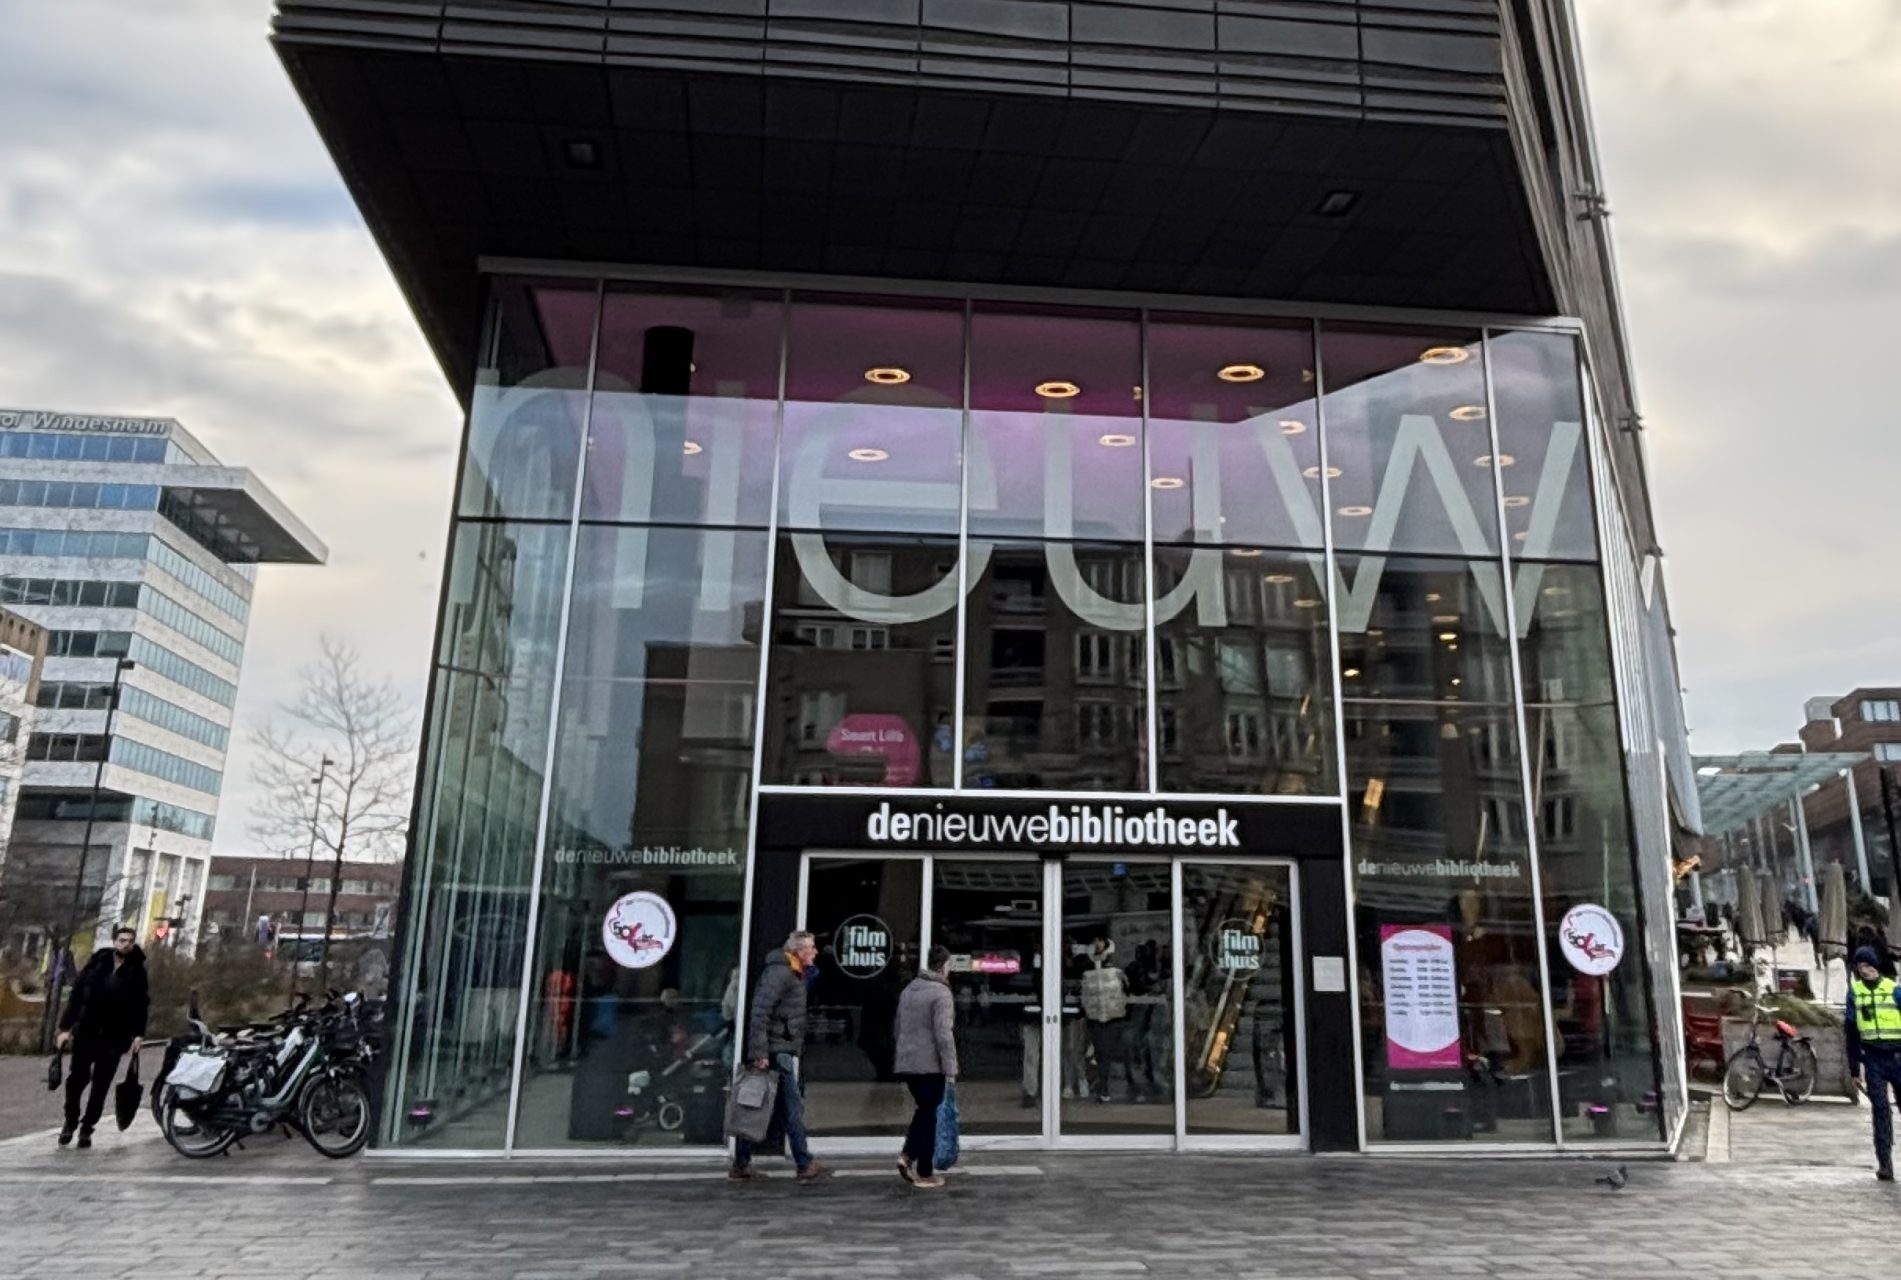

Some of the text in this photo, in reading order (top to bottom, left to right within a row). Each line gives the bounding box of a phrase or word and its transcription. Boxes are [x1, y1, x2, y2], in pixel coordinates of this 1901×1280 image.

[0, 411, 168, 434] ol Windesheim
[867, 802, 1241, 847] denieuwebibliotheek
[554, 845, 738, 866] denieuwebibliotheek
[1357, 857, 1521, 878] denieuwebibliotheek
[849, 925, 888, 948] film
[1222, 929, 1260, 951] film
[848, 946, 887, 967] huis
[1223, 950, 1261, 970] huis
